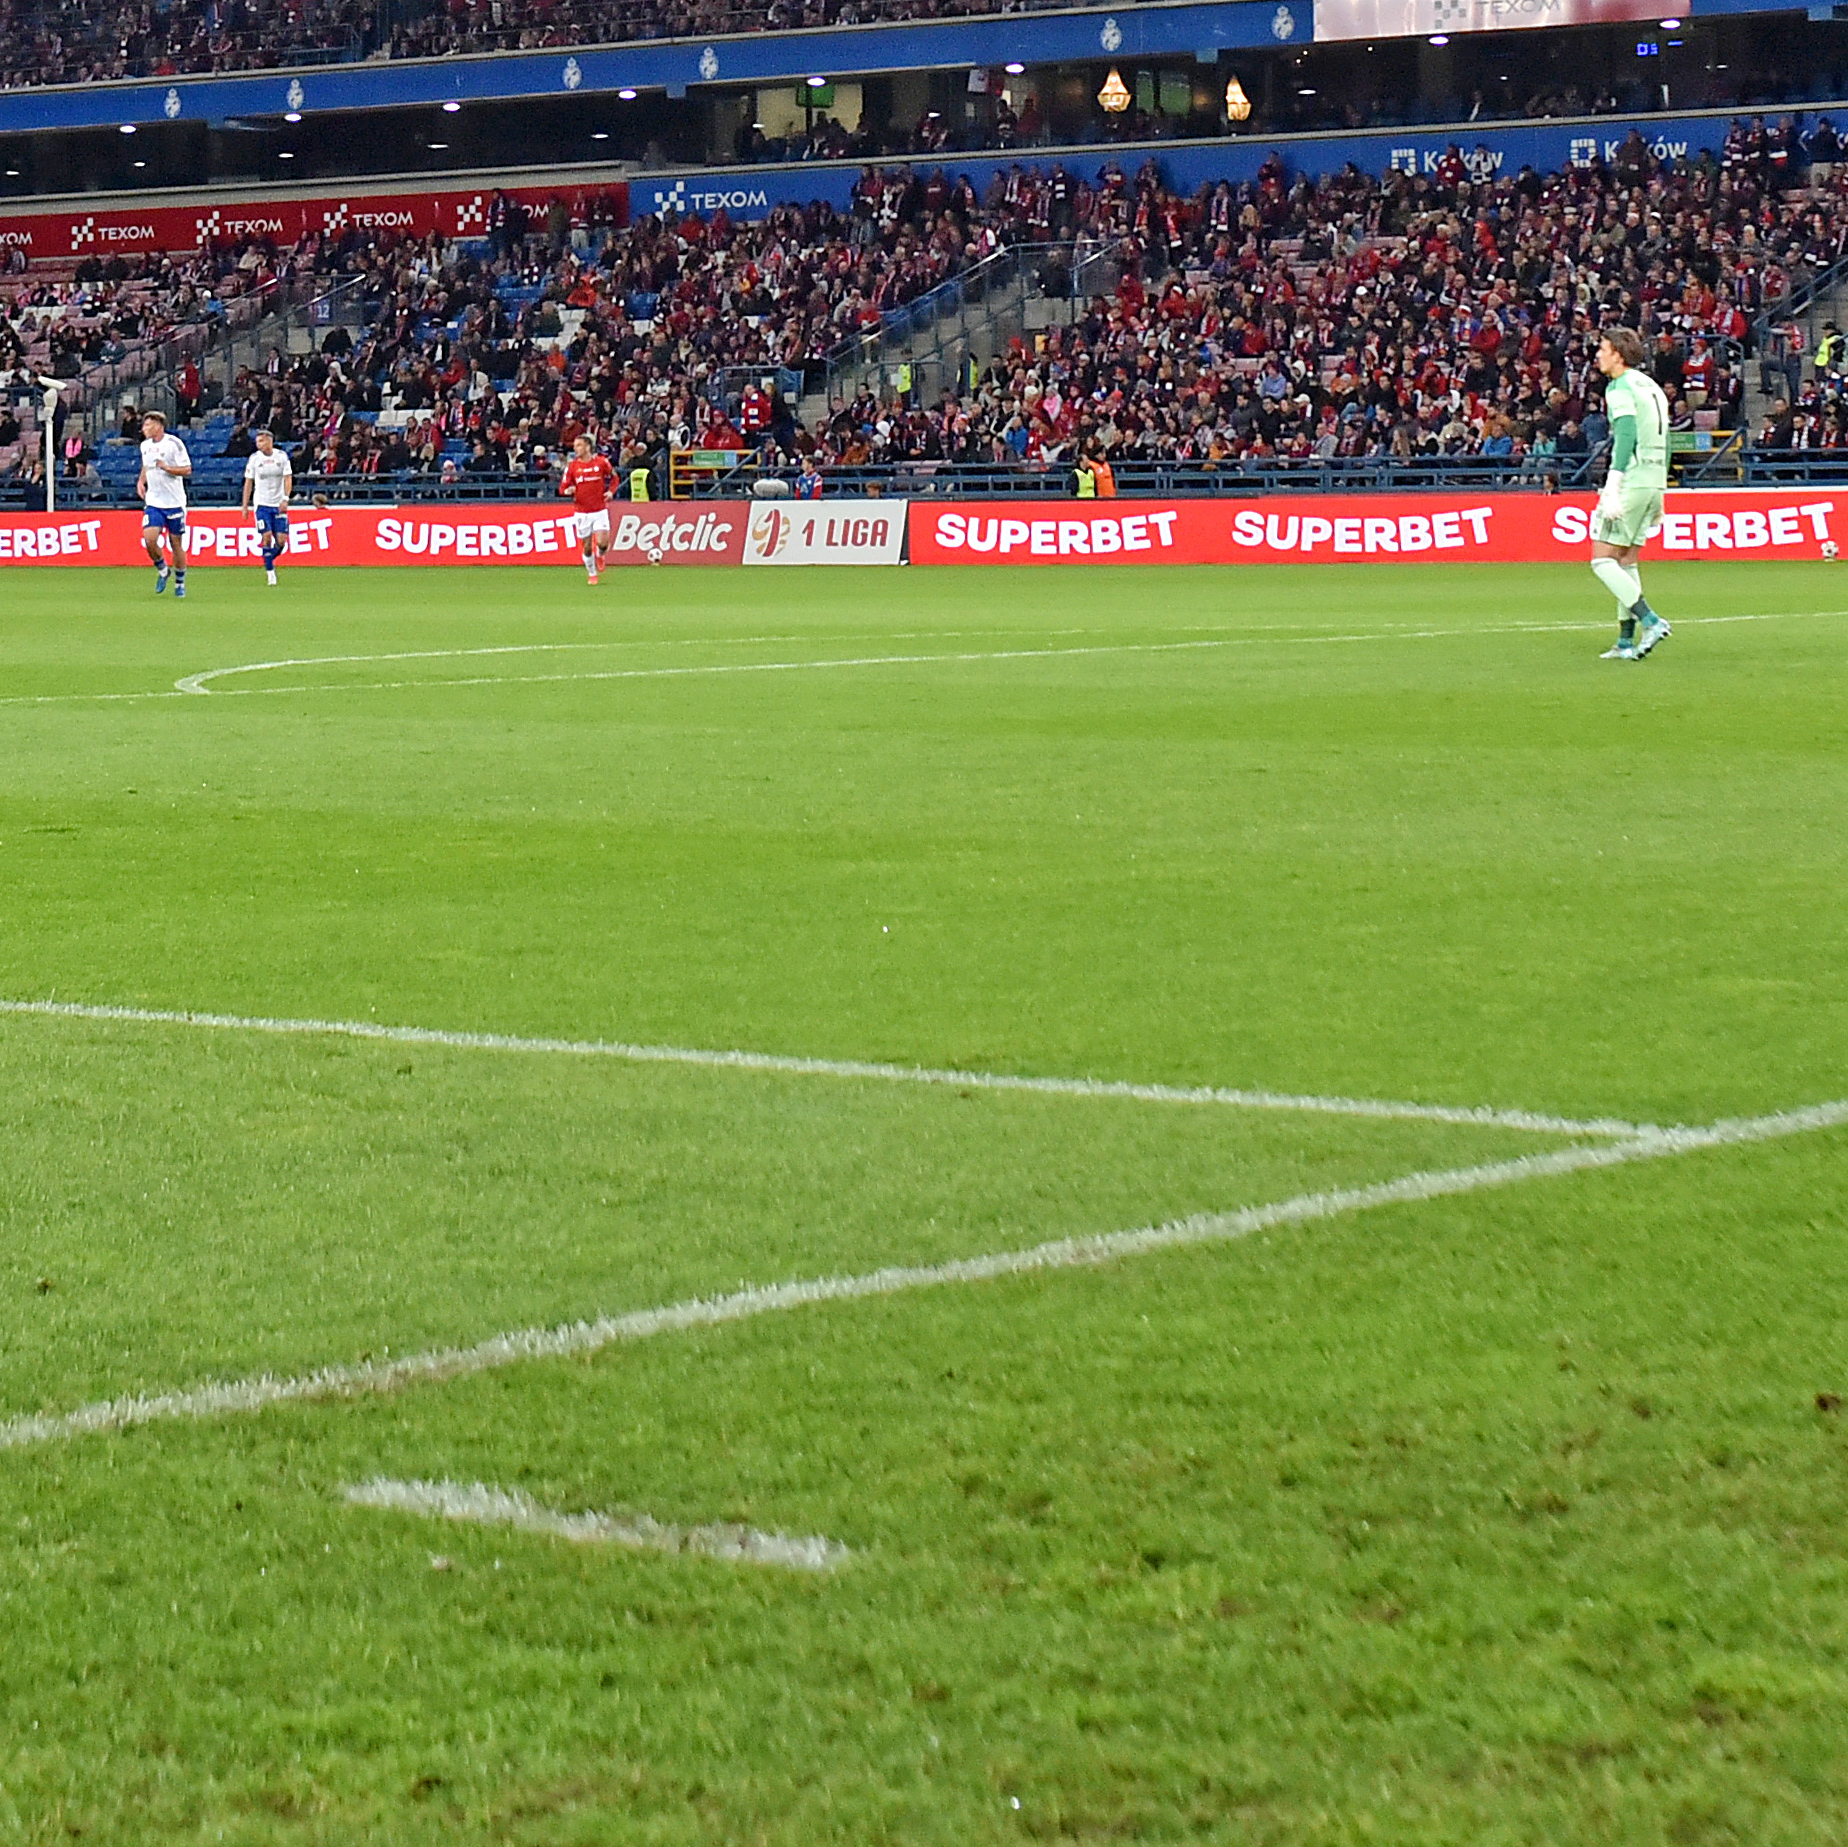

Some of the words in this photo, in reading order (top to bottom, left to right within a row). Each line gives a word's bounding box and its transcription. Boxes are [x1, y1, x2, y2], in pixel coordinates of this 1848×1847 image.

[353, 211, 414, 227] TEXOM
[691, 190, 768, 209] TEXOM
[98, 225, 154, 240] TEXOM
[1652, 393, 1662, 435] 1
[375, 515, 578, 556] SUPERBET
[613, 512, 732, 551] Betclic
[802, 519, 815, 547] 1
[825, 518, 889, 547] LIGA
[935, 511, 1178, 555] SUPERBET
[1232, 507, 1493, 552] SUPERBET
